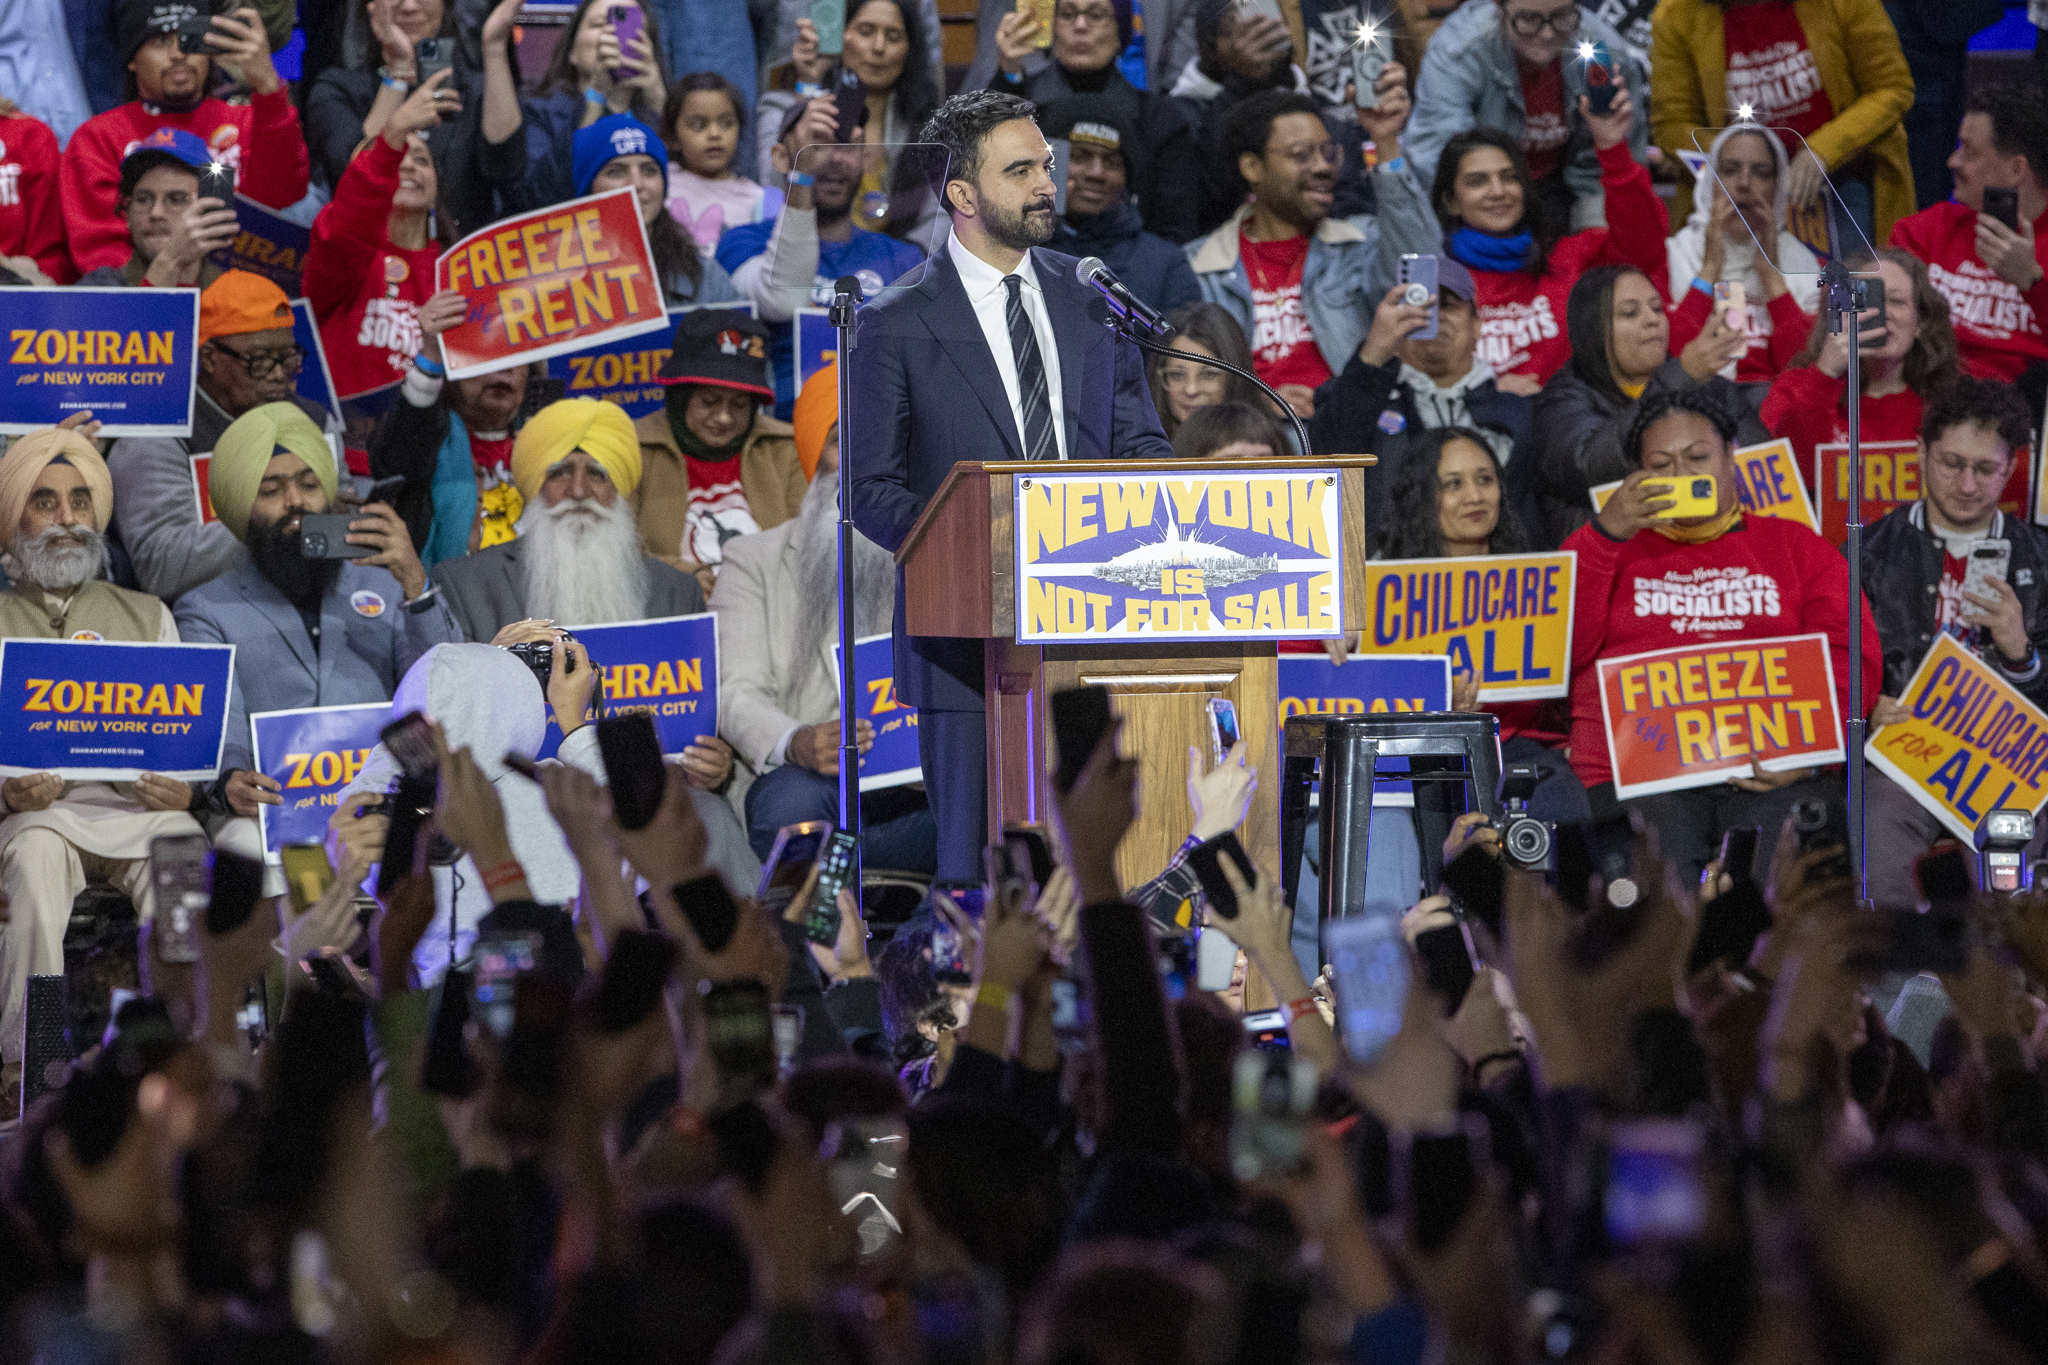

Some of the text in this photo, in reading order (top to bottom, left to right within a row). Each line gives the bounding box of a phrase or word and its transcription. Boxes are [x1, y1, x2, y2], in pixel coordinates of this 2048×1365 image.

[448, 208, 610, 291] FREEZE
[497, 264, 640, 346] RENT
[9, 329, 174, 365] ZOHRAN
[43, 371, 83, 385] NEW
[86, 372, 128, 385] YORK
[131, 372, 165, 385] CITY
[1026, 478, 1332, 564] NEW YORK
[1161, 568, 1203, 595] IS
[1634, 574, 1778, 597] DEMOCRATIC
[1028, 570, 1333, 634] NOT FOR SALE
[1375, 565, 1560, 647] CHILDCARE
[1634, 589, 1782, 617] SOCIALISTS
[1688, 617, 1745, 632] America
[1445, 624, 1551, 684] ALL
[22, 678, 205, 716] ZOHRAN
[1619, 648, 1793, 713] FREEZE
[661, 700, 698, 716] CITY
[56, 720, 98, 733] NEW
[102, 721, 148, 734] YORK
[151, 722, 192, 735] CITY
[1636, 700, 1821, 767] THE RENT
[1887, 732, 1944, 763] FOR
